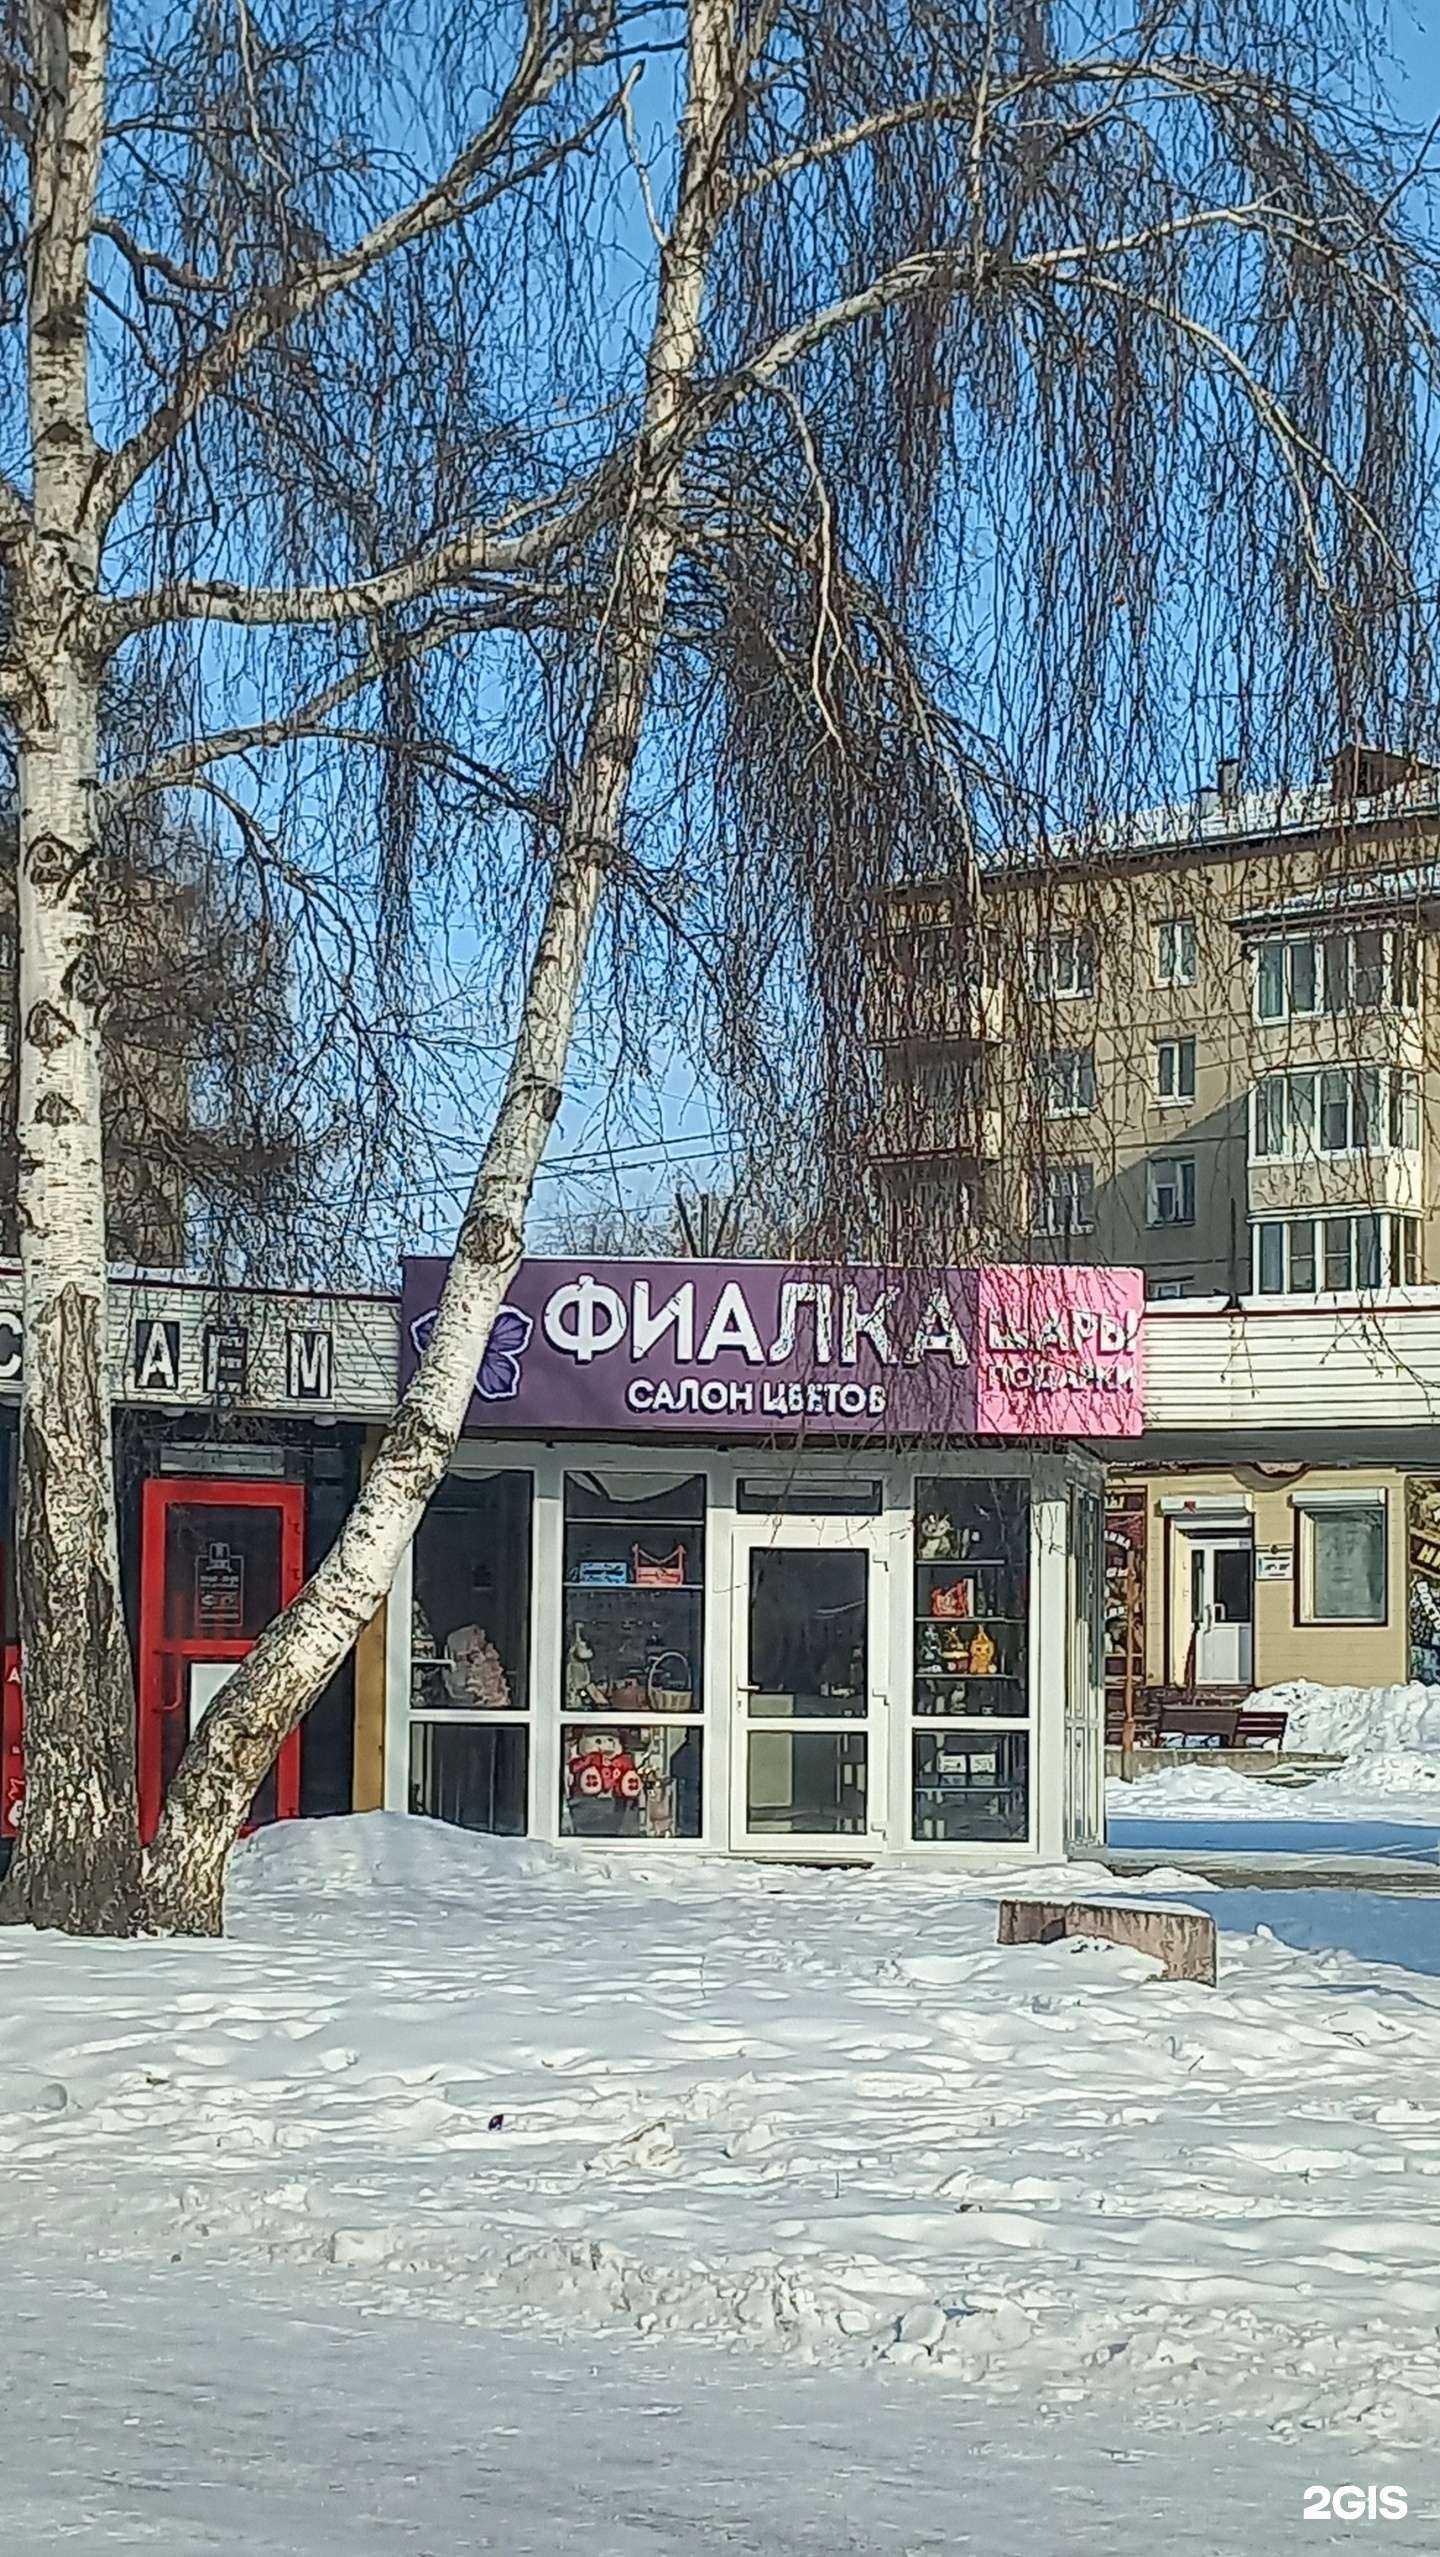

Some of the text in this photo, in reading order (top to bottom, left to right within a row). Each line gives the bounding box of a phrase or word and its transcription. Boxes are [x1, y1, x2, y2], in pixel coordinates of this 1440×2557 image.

[543, 1273, 971, 1366] ФИАЛКА
[628, 1378, 887, 1414] САЛОН ЦВЕТОВ
